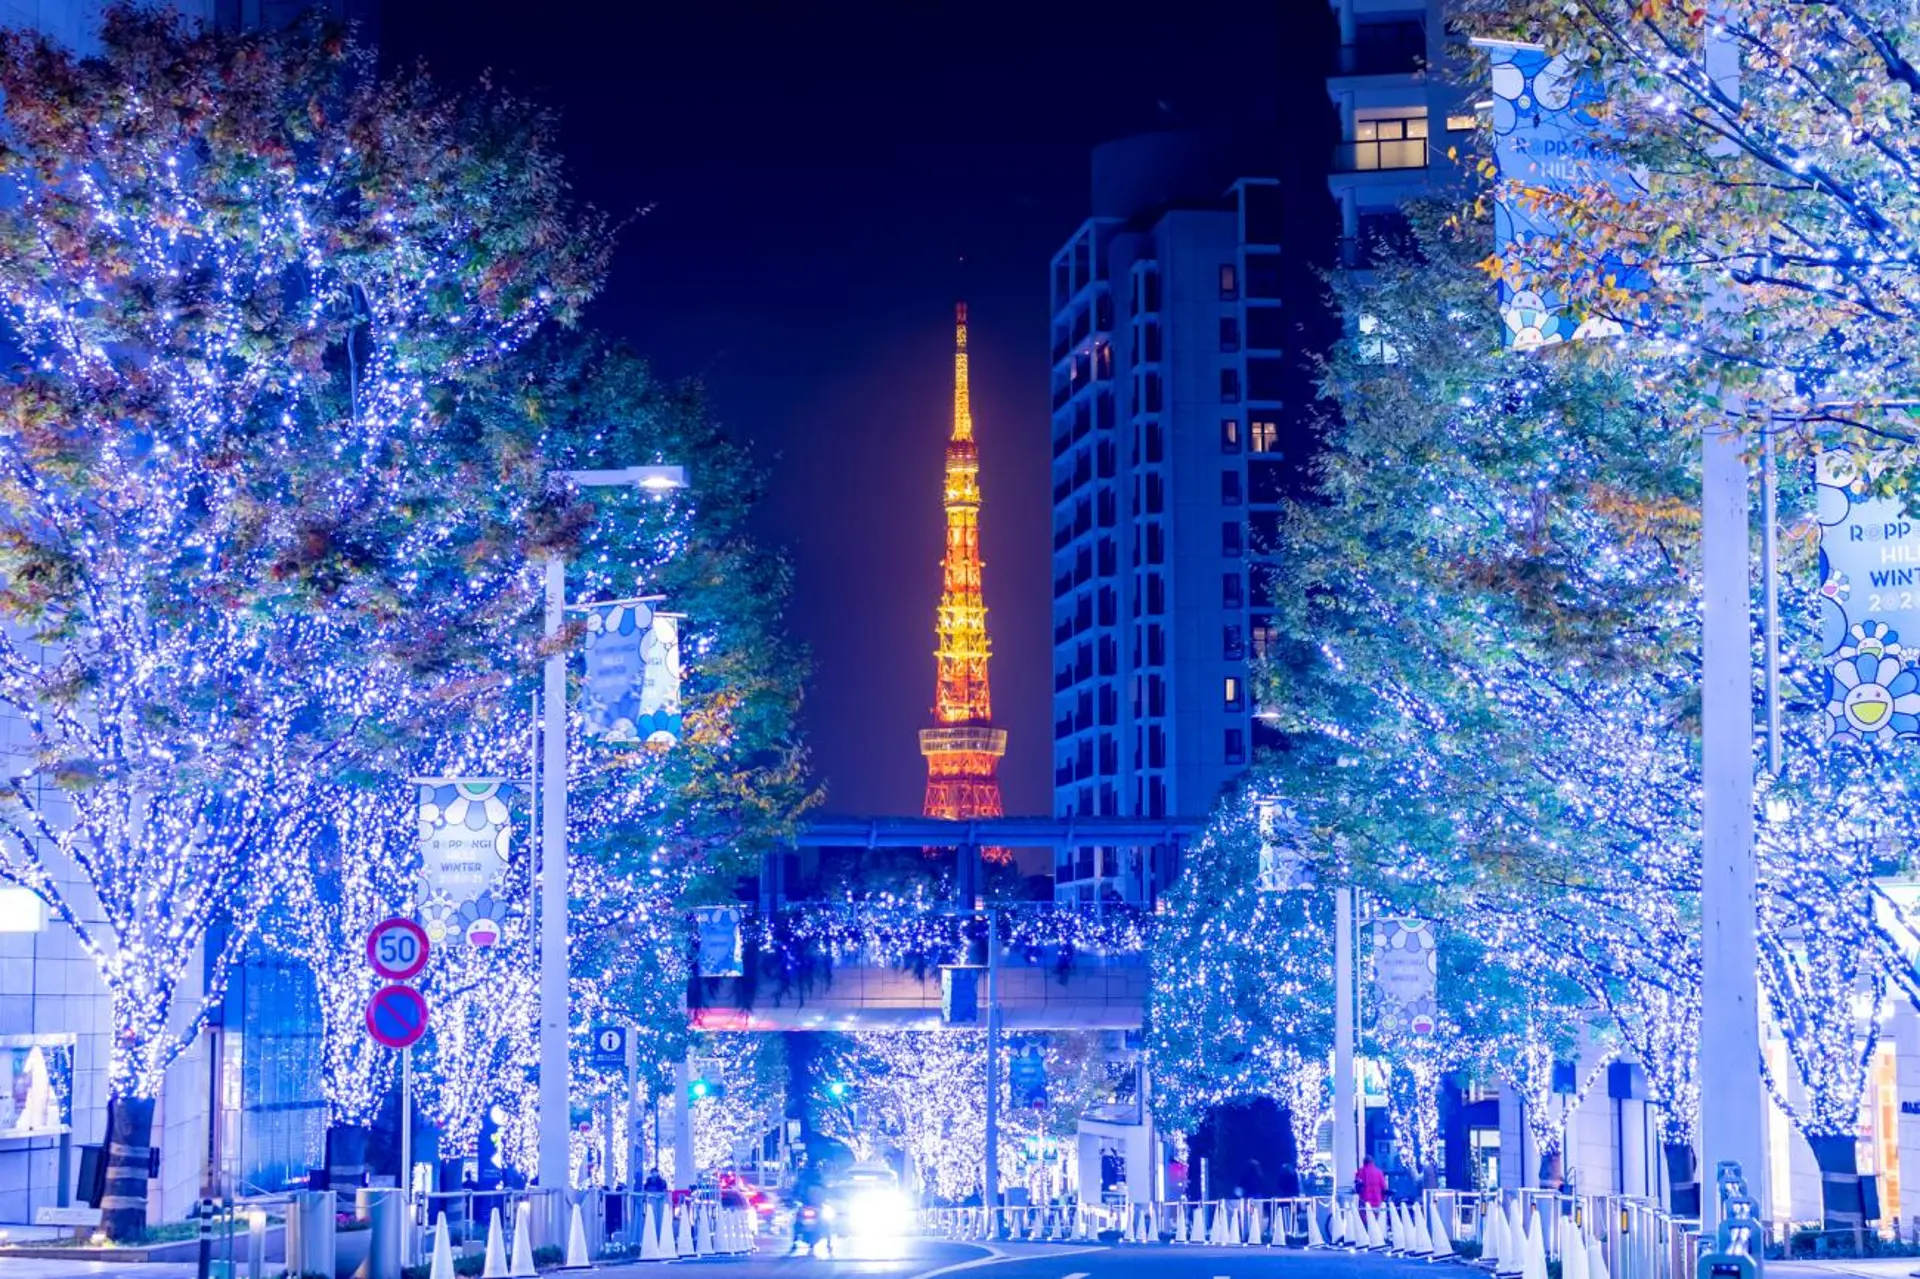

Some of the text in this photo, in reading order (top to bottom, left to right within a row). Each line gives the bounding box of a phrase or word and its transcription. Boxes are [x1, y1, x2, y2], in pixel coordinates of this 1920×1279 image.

[1881, 544, 1920, 564] HIL
[440, 862, 482, 872] WINTER
[381, 935, 415, 962] 50
